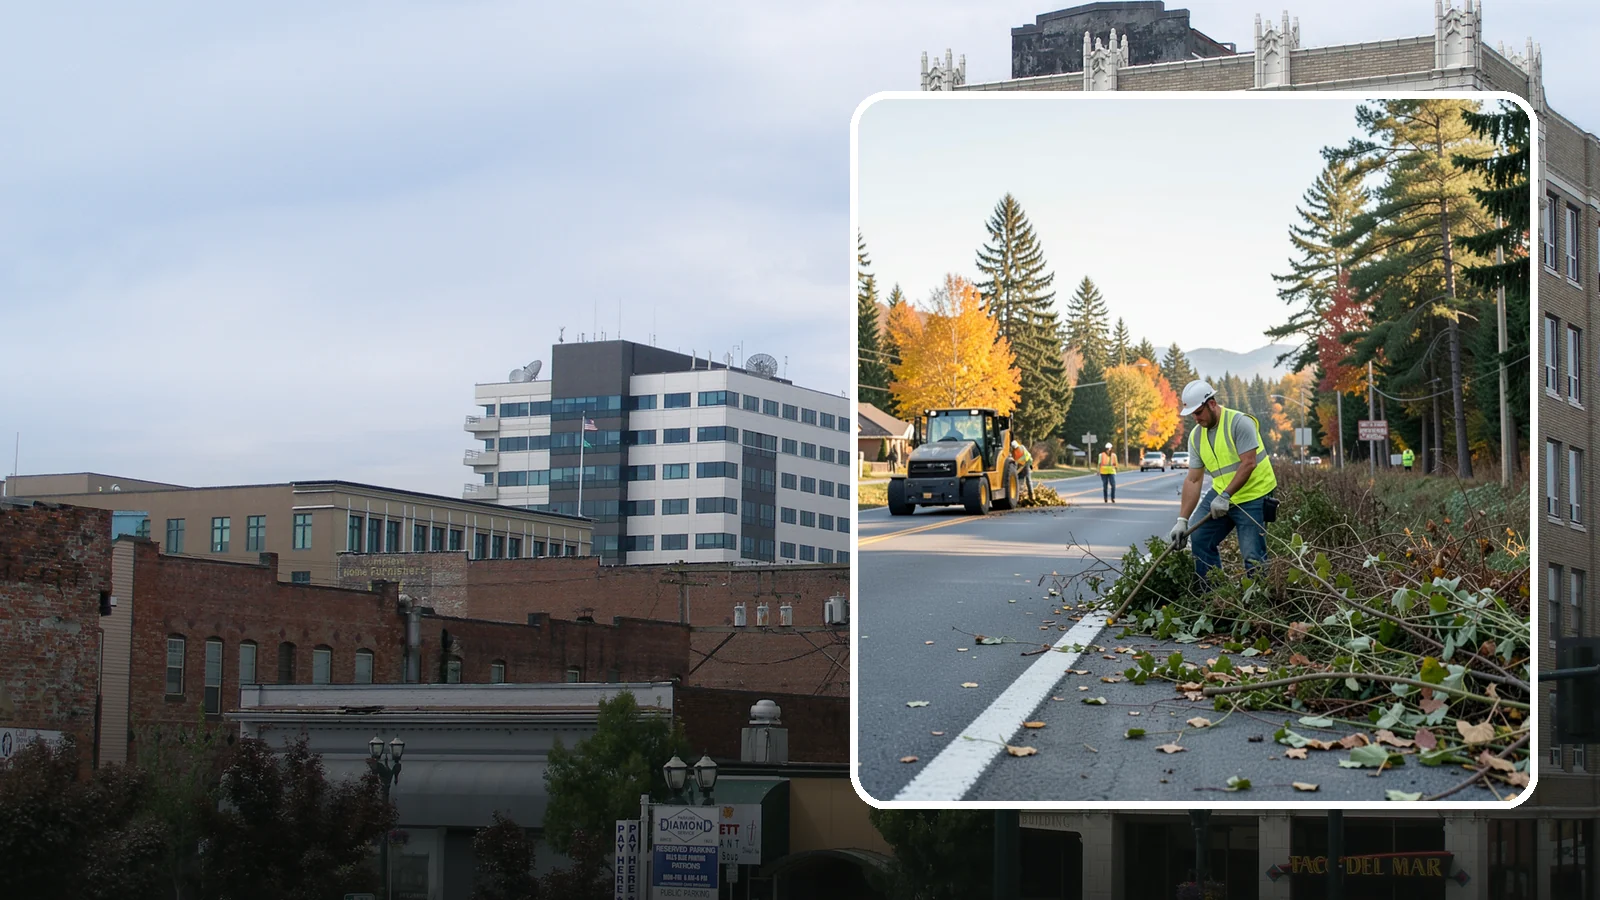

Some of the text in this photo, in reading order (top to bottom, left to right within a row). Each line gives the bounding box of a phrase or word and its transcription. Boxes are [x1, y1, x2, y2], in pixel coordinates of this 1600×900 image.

[370, 566, 427, 576] Furnishers
[660, 818, 713, 833] DIAMOND
[1022, 815, 1070, 828] BUILDING
[655, 845, 716, 854] RESERVED PARKING
[616, 825, 625, 894] PAY HERE
[627, 824, 637, 893] PAY HERE
[721, 851, 739, 862] Soup
[671, 862, 701, 870] PATRONS
[1290, 855, 1442, 877] TAC DEL MAR
[660, 888, 710, 898] PUBLIC PARKING
